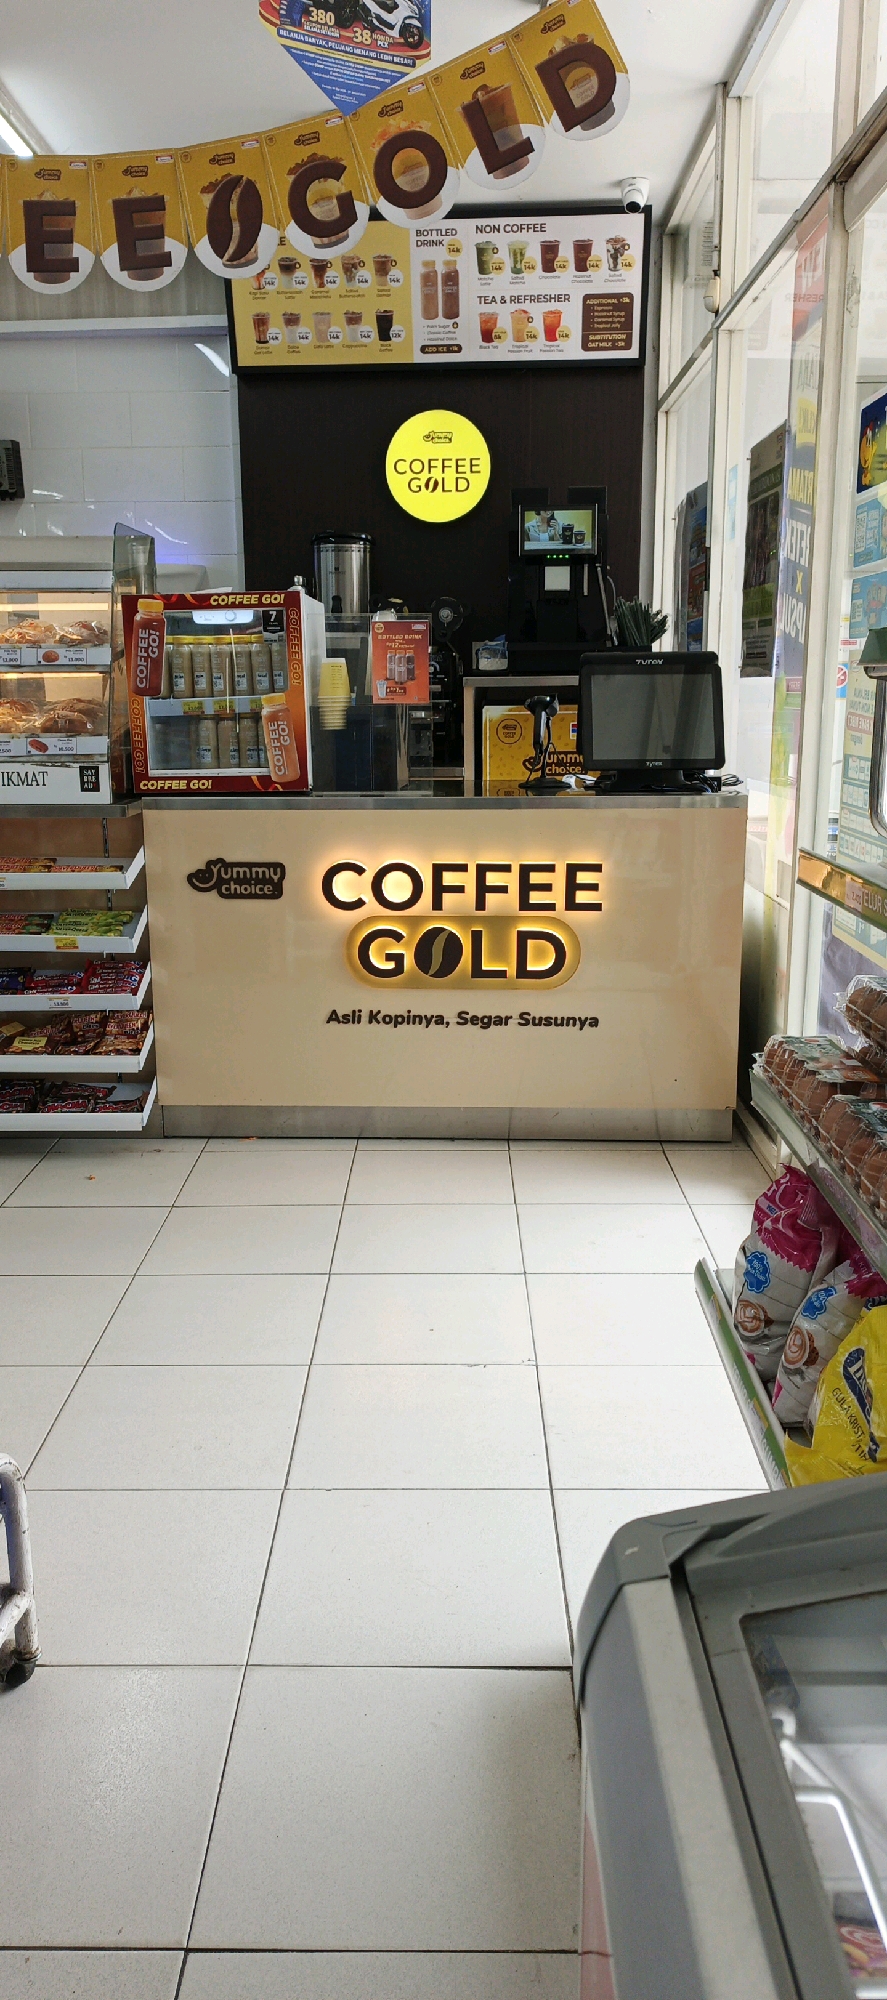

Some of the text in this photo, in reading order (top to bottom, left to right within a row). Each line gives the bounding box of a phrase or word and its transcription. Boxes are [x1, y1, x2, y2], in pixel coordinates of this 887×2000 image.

[309, 7, 334, 26] 380
[279, 30, 305, 42] BELANJA
[352, 28, 371, 45] 38
[372, 33, 394, 44] HONDA
[416, 228, 458, 237] BOTTLED
[476, 223, 546, 234] NON COFFEE
[416, 240, 444, 248] DRINK
[477, 294, 571, 304] TEA & REFRESHER
[394, 458, 481, 475] COFFEE
[408, 476, 470, 494] GOLD
[210, 594, 286, 606] COFFEE GO!
[269, 610, 277, 622] 7
[149, 630, 160, 658] GO!
[289, 608, 302, 686] COFFEE GO!
[137, 628, 148, 688] COFFEE
[131, 697, 145, 774] COFFEE GO!
[278, 720, 290, 746] GO!
[268, 721, 285, 776] COFFEE
[140, 780, 212, 790] COFFEE GO!
[205, 862, 280, 883] Yummy
[321, 861, 602, 912] COFFEE
[357, 926, 566, 980] GOLD
[326, 1009, 600, 1031] Asli Kopinya, Segar Susunya
[832, 1387, 852, 1412] GULA
